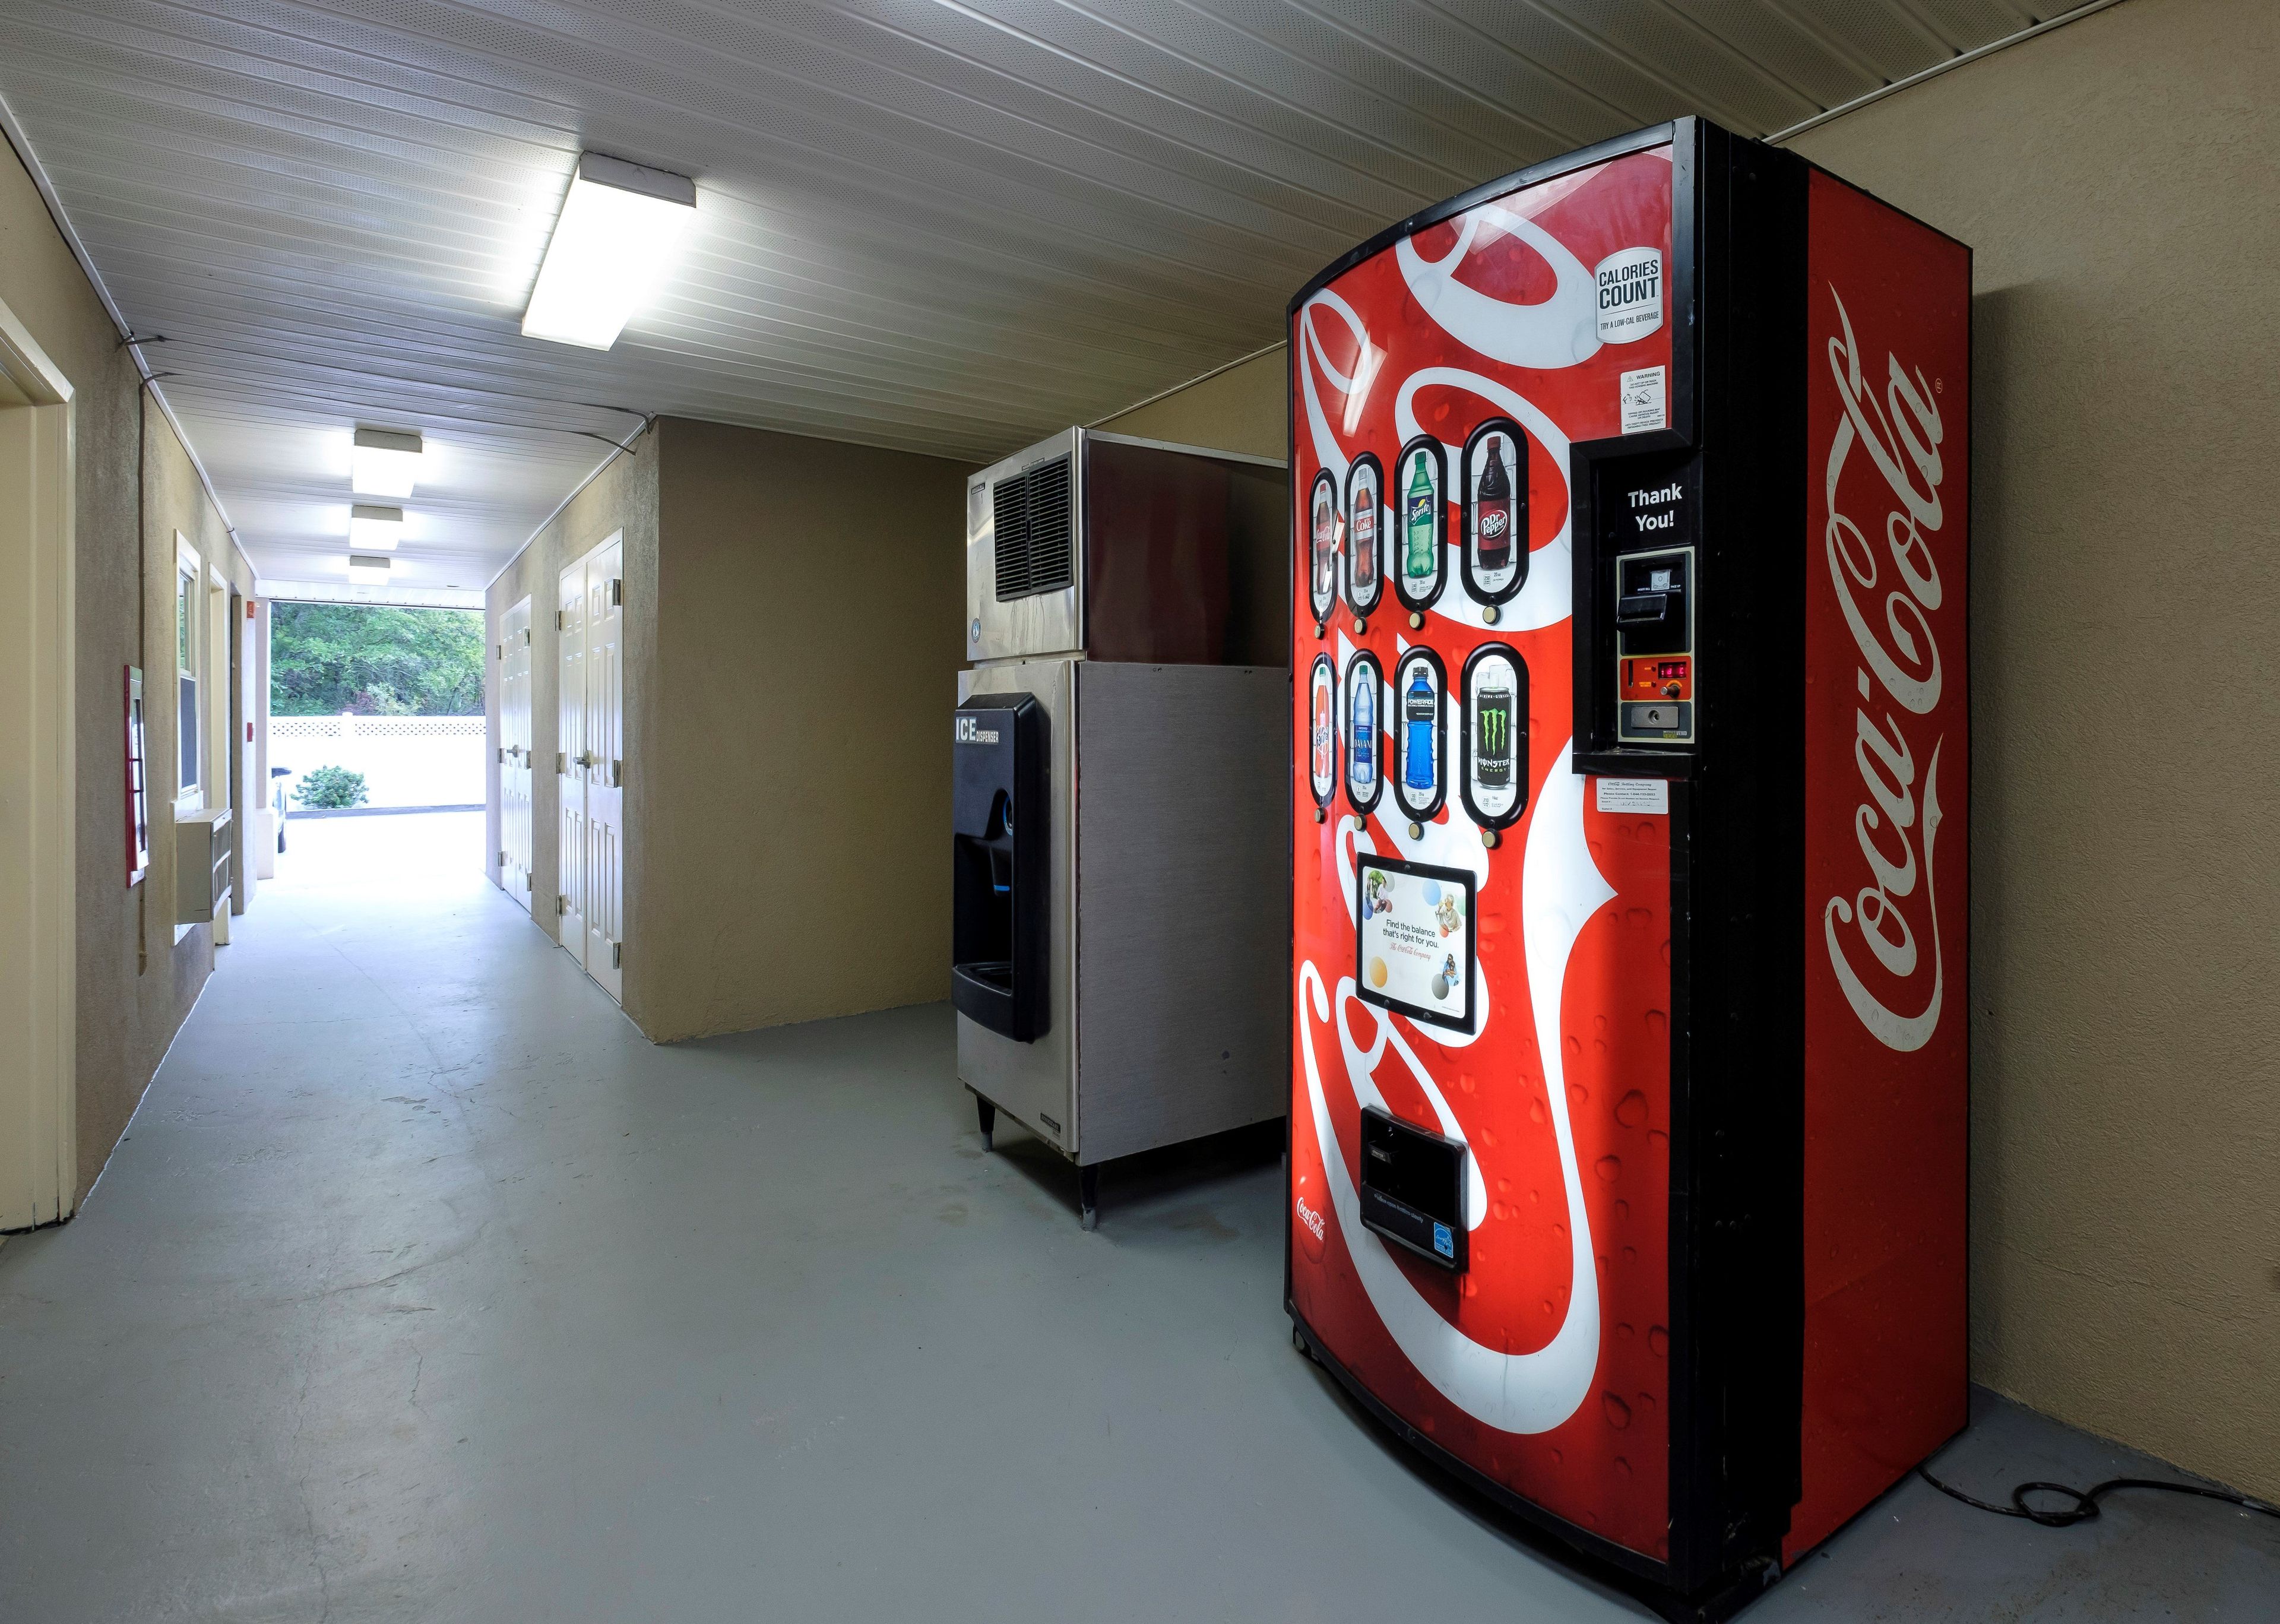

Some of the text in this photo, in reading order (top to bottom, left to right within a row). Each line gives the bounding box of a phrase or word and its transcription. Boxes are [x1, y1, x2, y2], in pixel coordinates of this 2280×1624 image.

[1599, 259, 1658, 287] CALORIES
[1600, 276, 1659, 309] COUNT
[1600, 322, 1609, 331] TRY
[1614, 316, 1635, 328] LOW-CAL
[1636, 311, 1659, 322] BEVERAGE
[1636, 371, 1661, 379] WARNING
[1627, 483, 1683, 508] Thank
[1411, 503, 1430, 521] Sprite
[1635, 510, 1674, 531] You!
[1356, 519, 1372, 531] Coke
[1481, 514, 1506, 536] Dr Pepper
[1824, 280, 1945, 1053] Coca-Cola
[956, 718, 976, 740] ICE
[976, 731, 999, 743] DISPENSER
[1478, 756, 1510, 768] MONSTER
[1383, 928, 1439, 949] that's right for you.
[1386, 919, 1436, 938] Find the balance
[1413, 948, 1431, 962] Company
[1297, 1196, 1325, 1241] Coca-Cola
